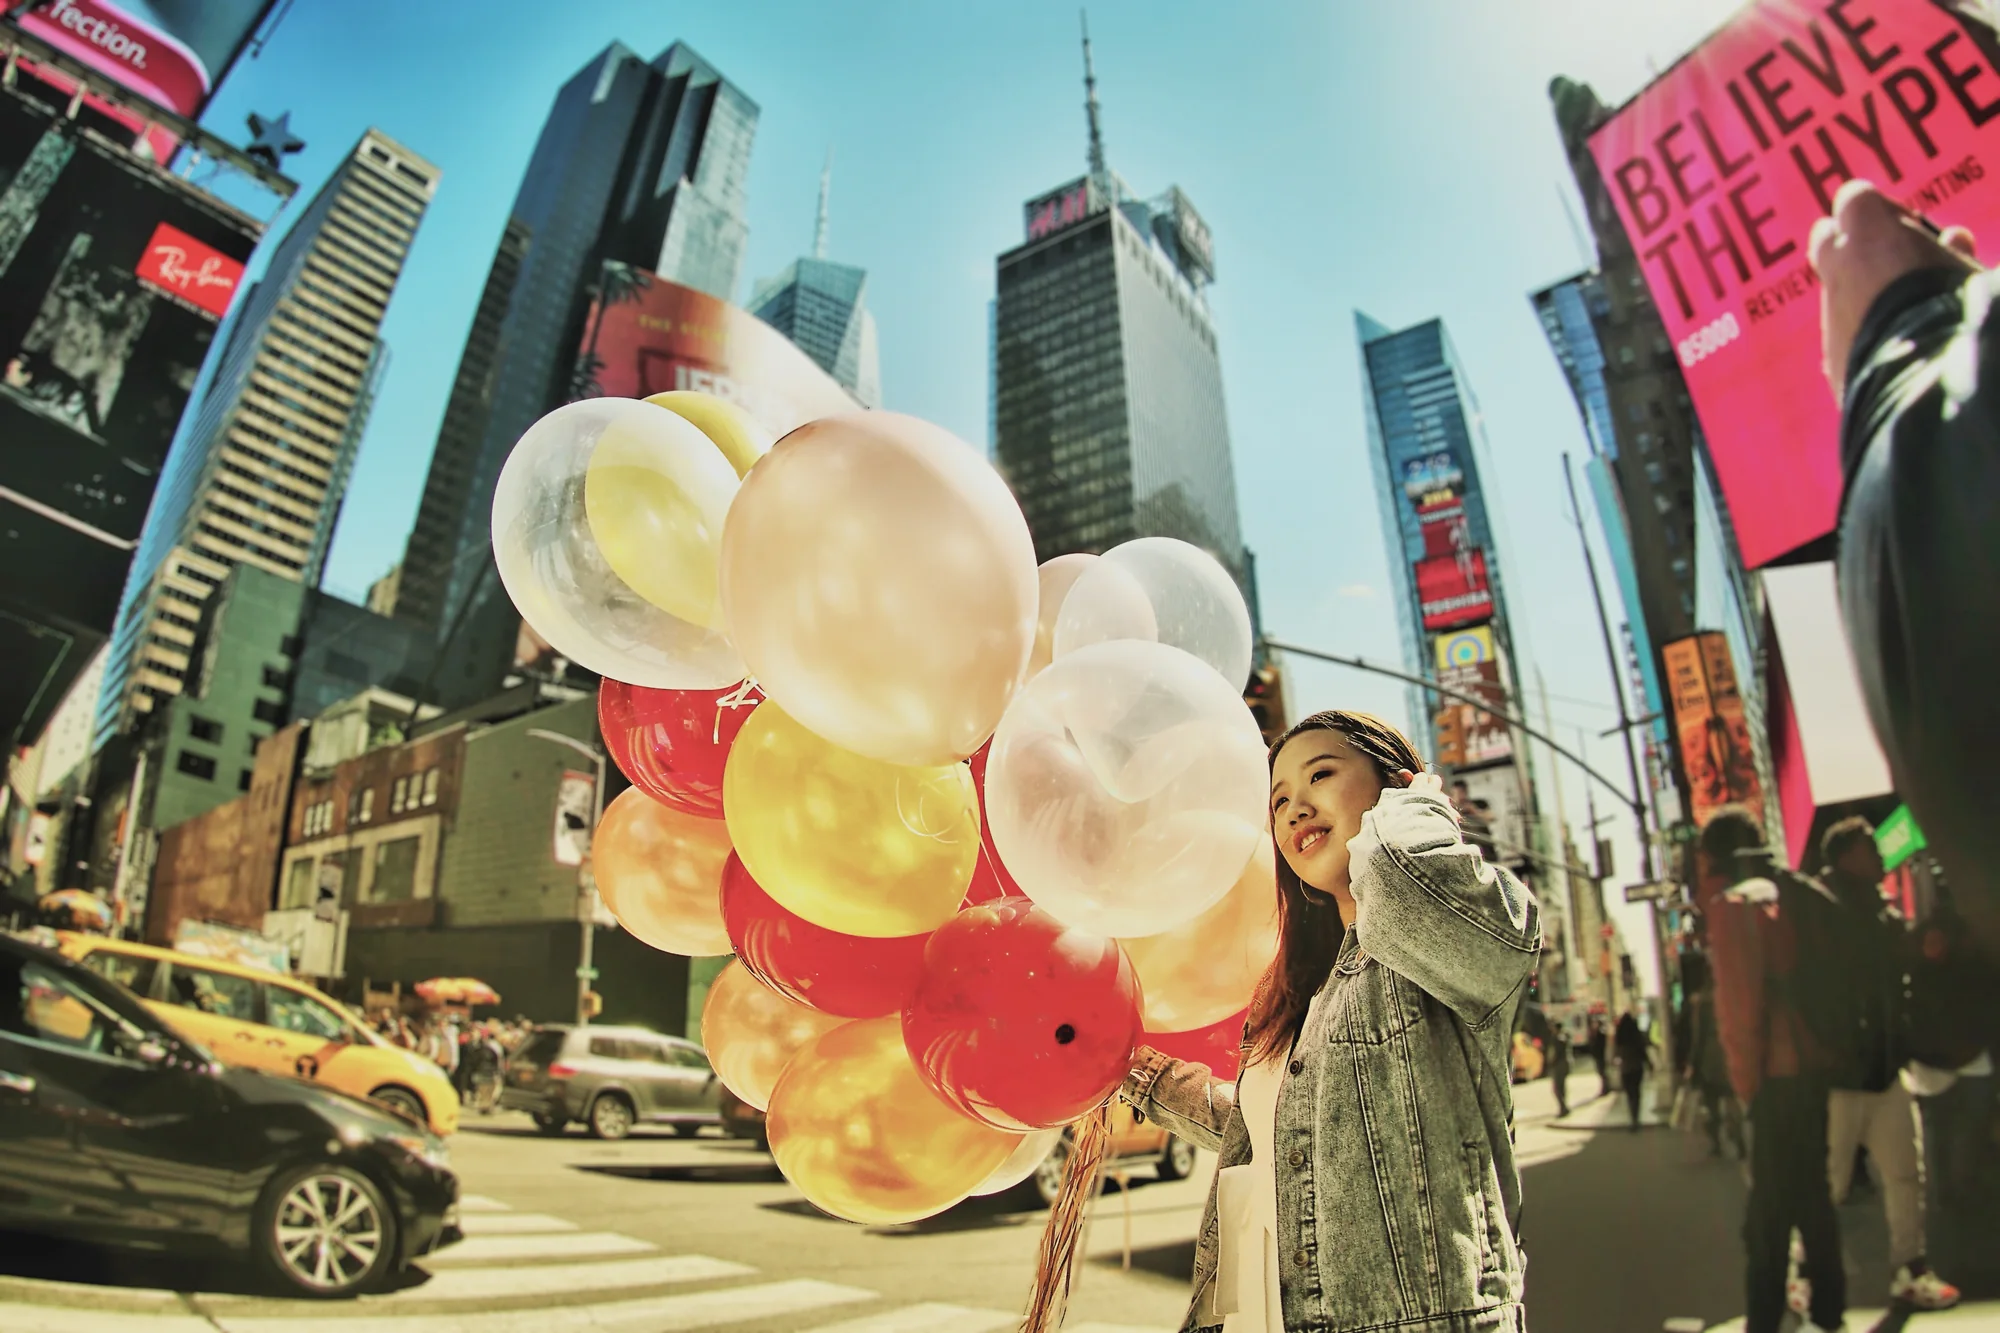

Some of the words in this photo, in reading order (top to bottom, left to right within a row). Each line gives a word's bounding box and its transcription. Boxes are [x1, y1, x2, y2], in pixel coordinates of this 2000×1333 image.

[38, 0, 147, 70] fection.
[1613, 0, 1903, 239] BELIEVE
[1643, 172, 1797, 321] THE
[1789, 30, 2000, 217] HYPE
[154, 244, 234, 291] Ray-Ban
[1422, 589, 1492, 617] TOSHIBA
